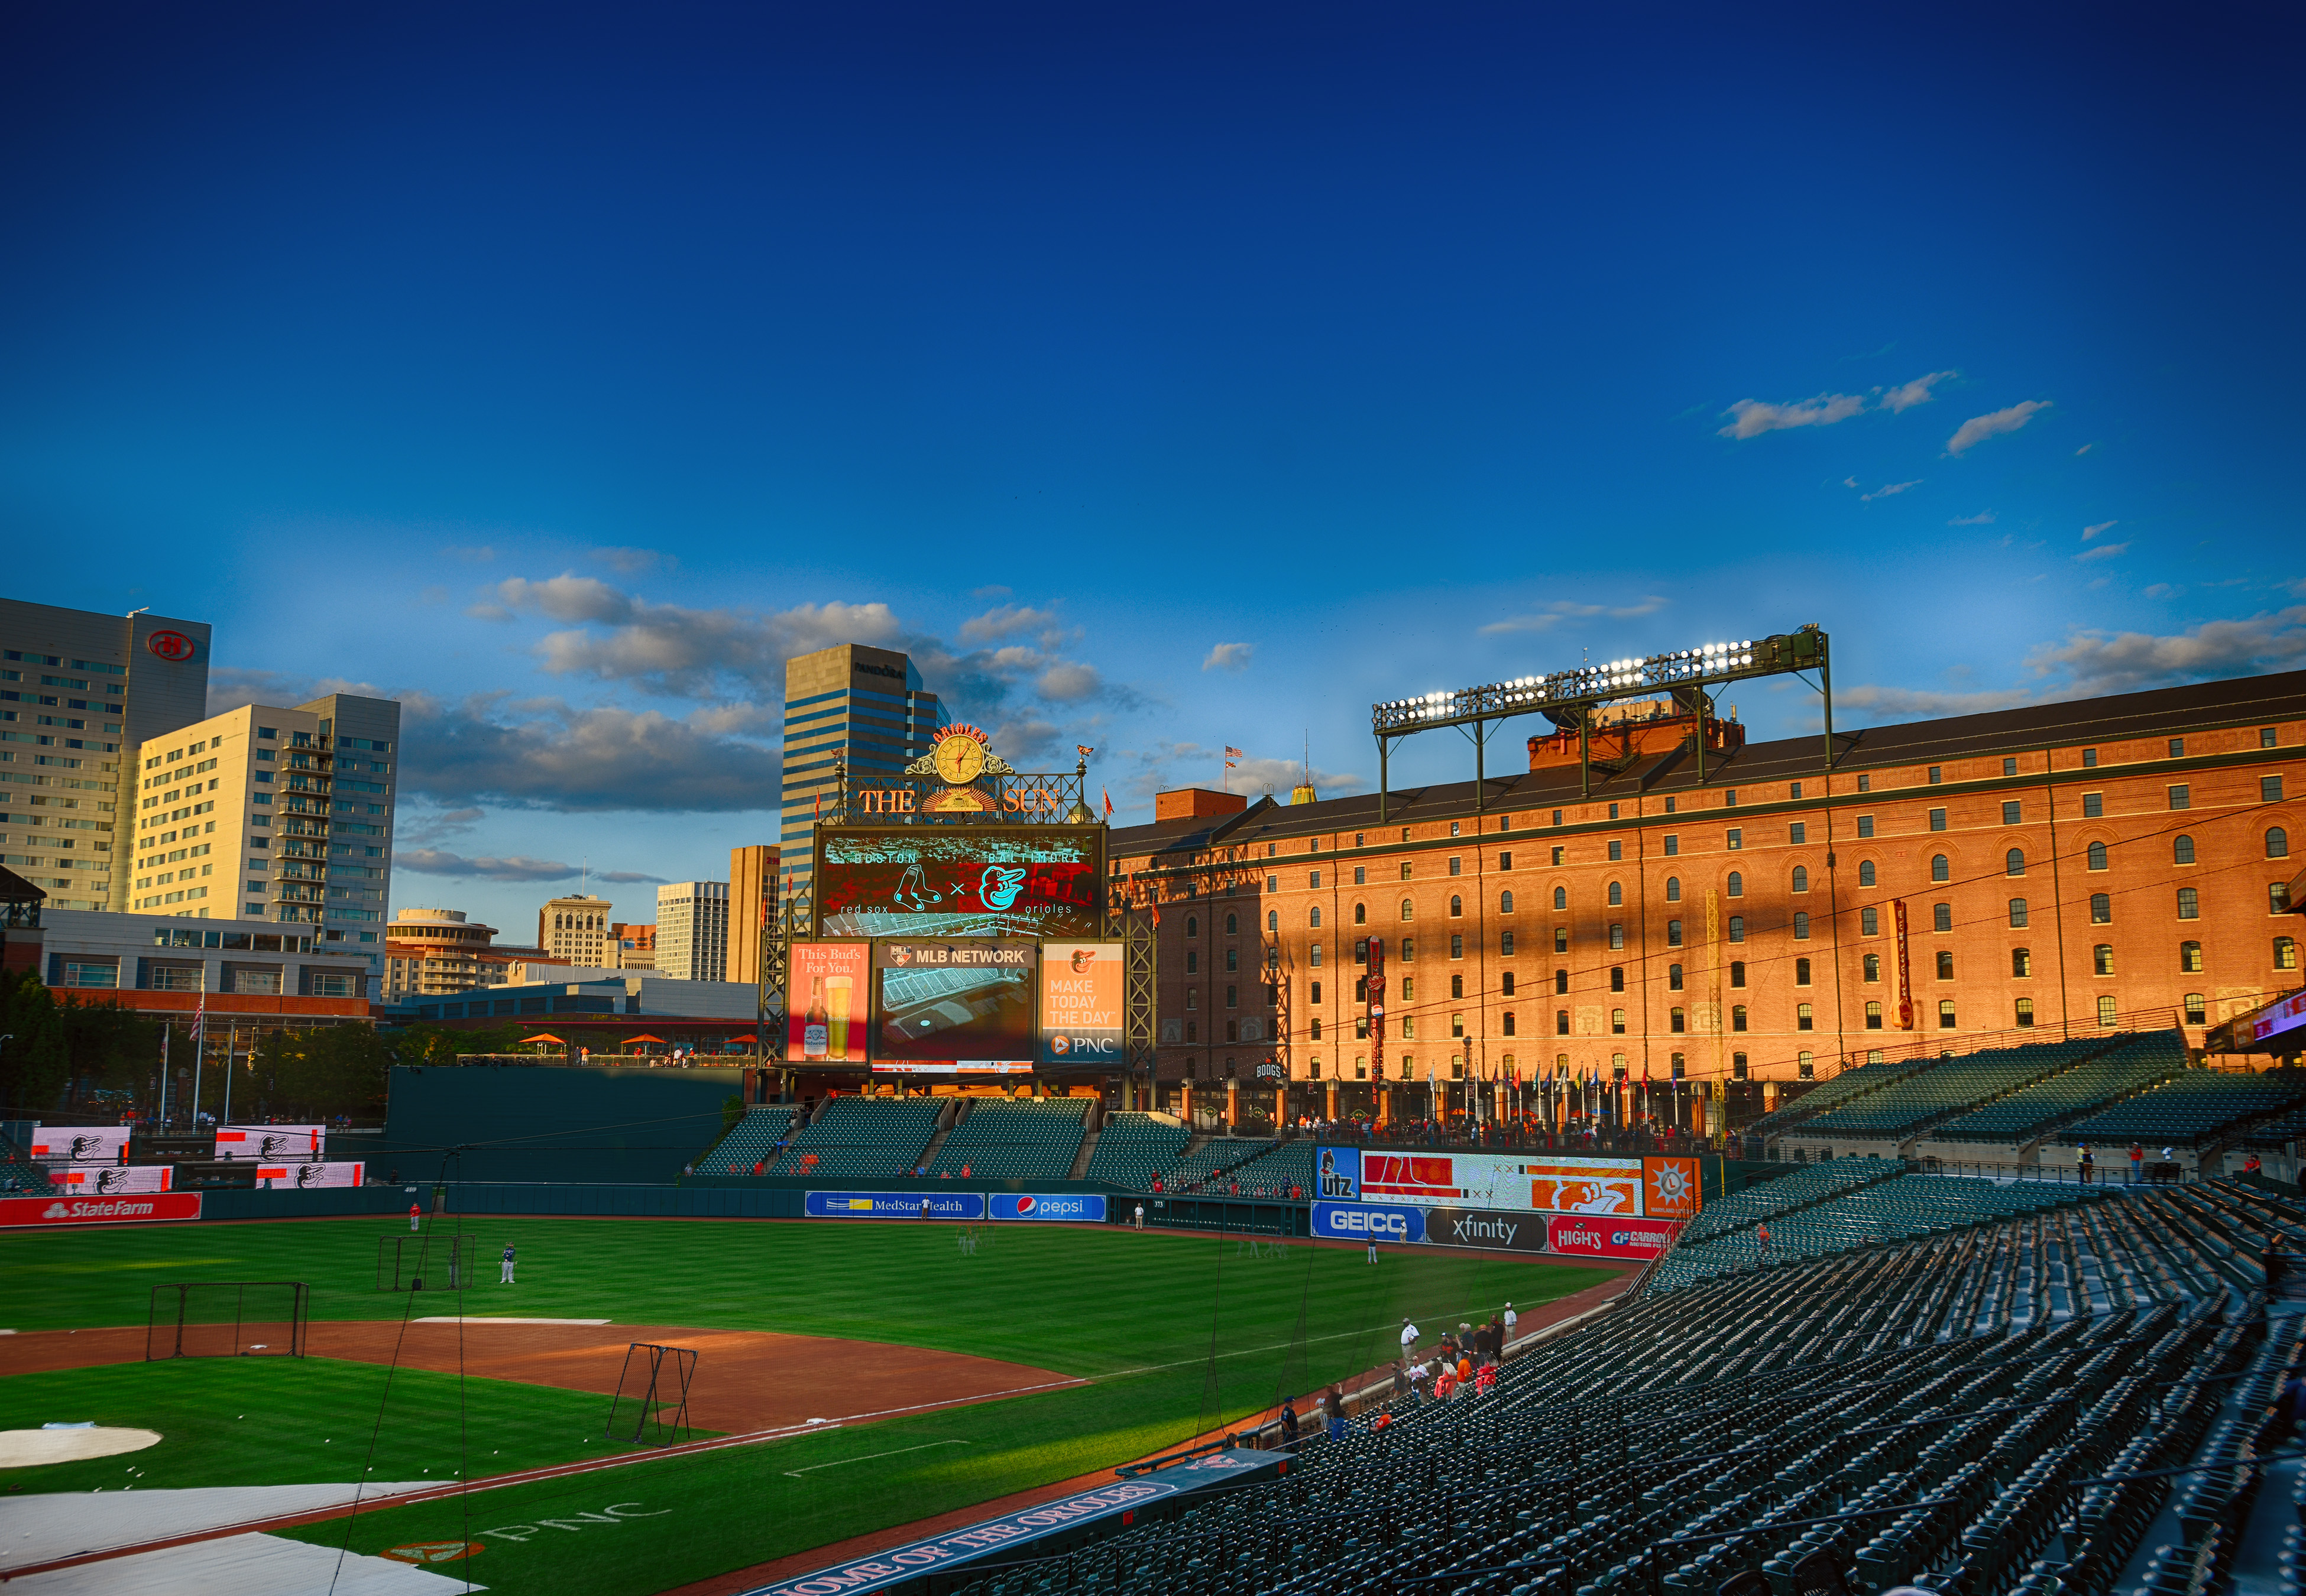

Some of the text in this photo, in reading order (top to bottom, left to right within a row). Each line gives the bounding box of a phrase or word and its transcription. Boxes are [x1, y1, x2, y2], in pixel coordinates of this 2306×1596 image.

[855, 663, 902, 680] PANDORA
[933, 722, 989, 744] ORIOLES
[859, 789, 1060, 813] THE SUN
[855, 854, 916, 864] BOSTON
[989, 853, 1080, 863] BALTIMORE
[841, 904, 861, 913] red
[1025, 904, 1071, 913] orioles
[799, 949, 860, 959] This Bud's
[916, 950, 1024, 963] MLB NETWORK
[806, 962, 853, 973] For You.
[1051, 980, 1093, 992] MAKE
[1050, 996, 1097, 1008] TODAY
[1050, 1011, 1078, 1024] THE
[1083, 1011, 1110, 1024] DAY
[1072, 1038, 1113, 1053] PNC
[1257, 1064, 1280, 1078] BOOG'S
[875, 1201, 922, 1211] MedStar
[1041, 1200, 1083, 1215] pepsi
[1330, 1211, 1403, 1233] GEICO
[1453, 1215, 1517, 1245] xfinity
[1558, 1230, 1602, 1250] HIGH'S
[474, 1503, 672, 1541] PNC
[892, 1546, 954, 1564] OF
[939, 1524, 1031, 1550] THE
[1018, 1485, 1157, 1526] ORIOLES
